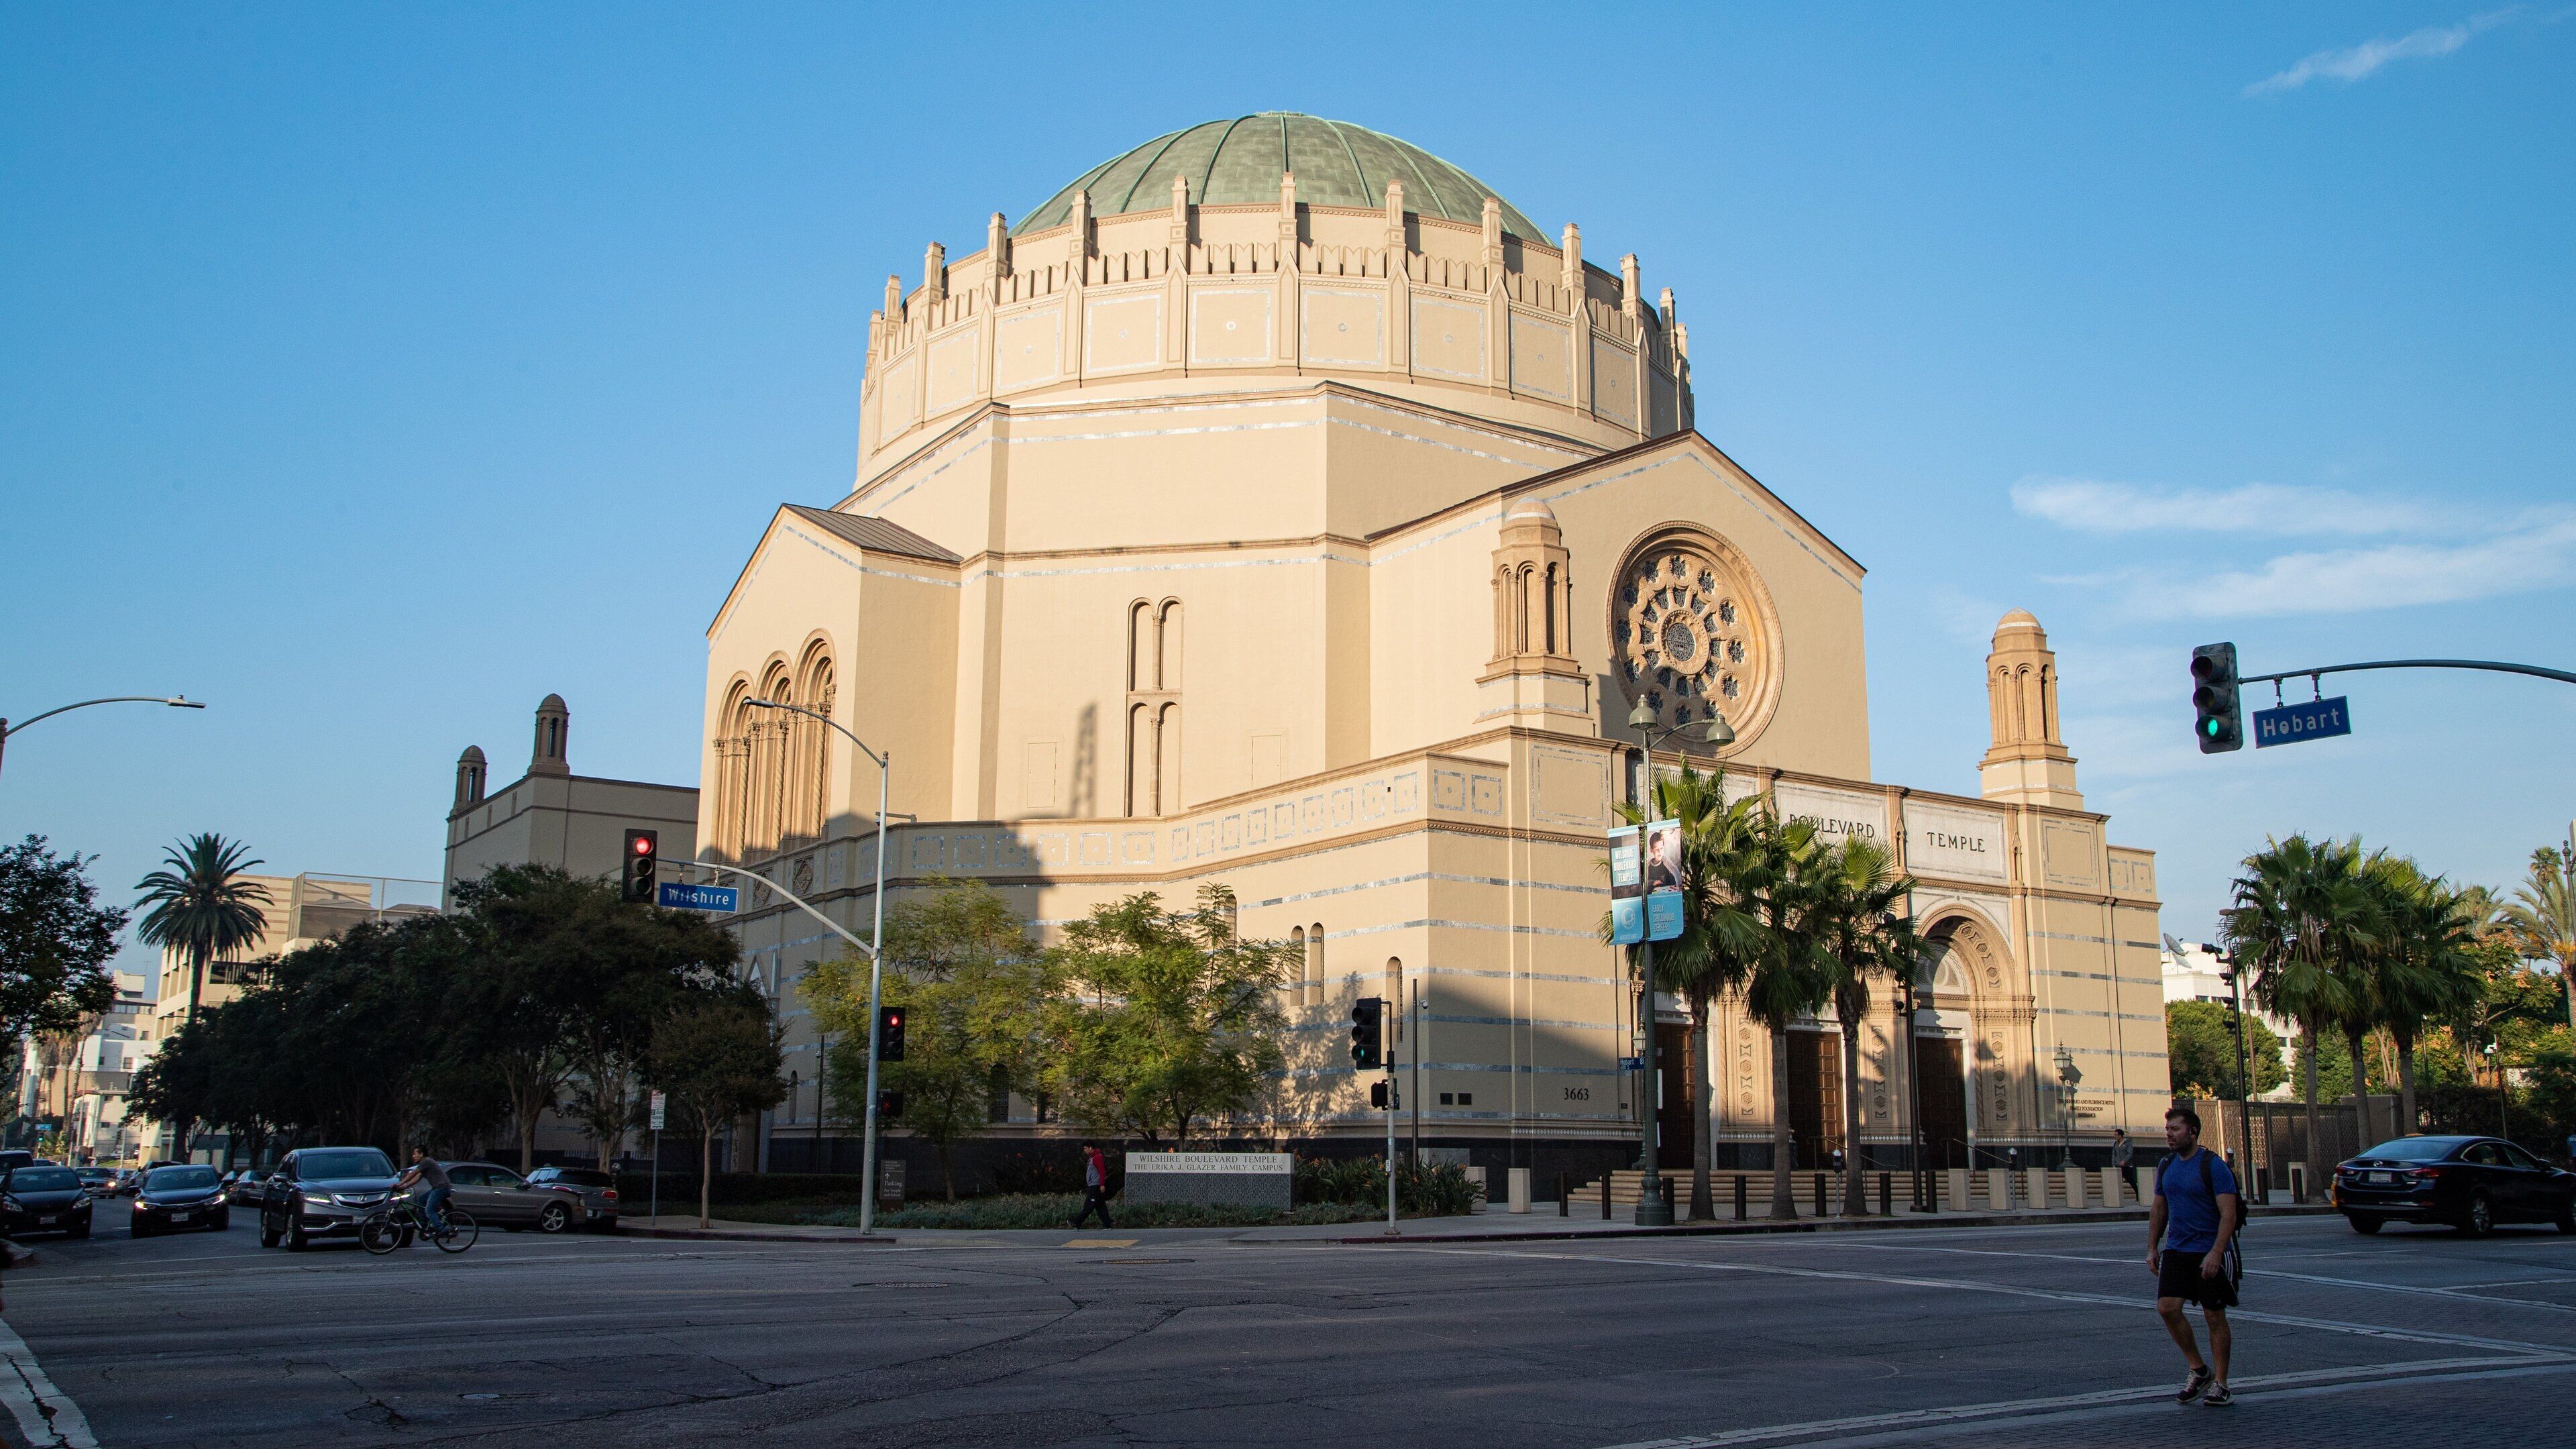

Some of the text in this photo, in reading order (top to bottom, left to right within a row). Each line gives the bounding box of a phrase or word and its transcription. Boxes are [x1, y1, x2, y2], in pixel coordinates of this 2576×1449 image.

[2262, 708, 2340, 737] Hobart
[1927, 832, 1985, 853] TEMPLE
[1614, 848, 1635, 859] WILSHIRE
[1613, 859, 1637, 872] BOULEVARD
[1617, 871, 1634, 883] TEMPLE
[668, 888, 729, 905] Wilshire
[1652, 904, 1664, 913] EARLY
[1653, 913, 1675, 922] CHILDHOOD
[1654, 923, 1669, 932] CENTER
[1564, 1087, 1589, 1100] 3663
[1243, 1155, 1277, 1163] TEMPLE
